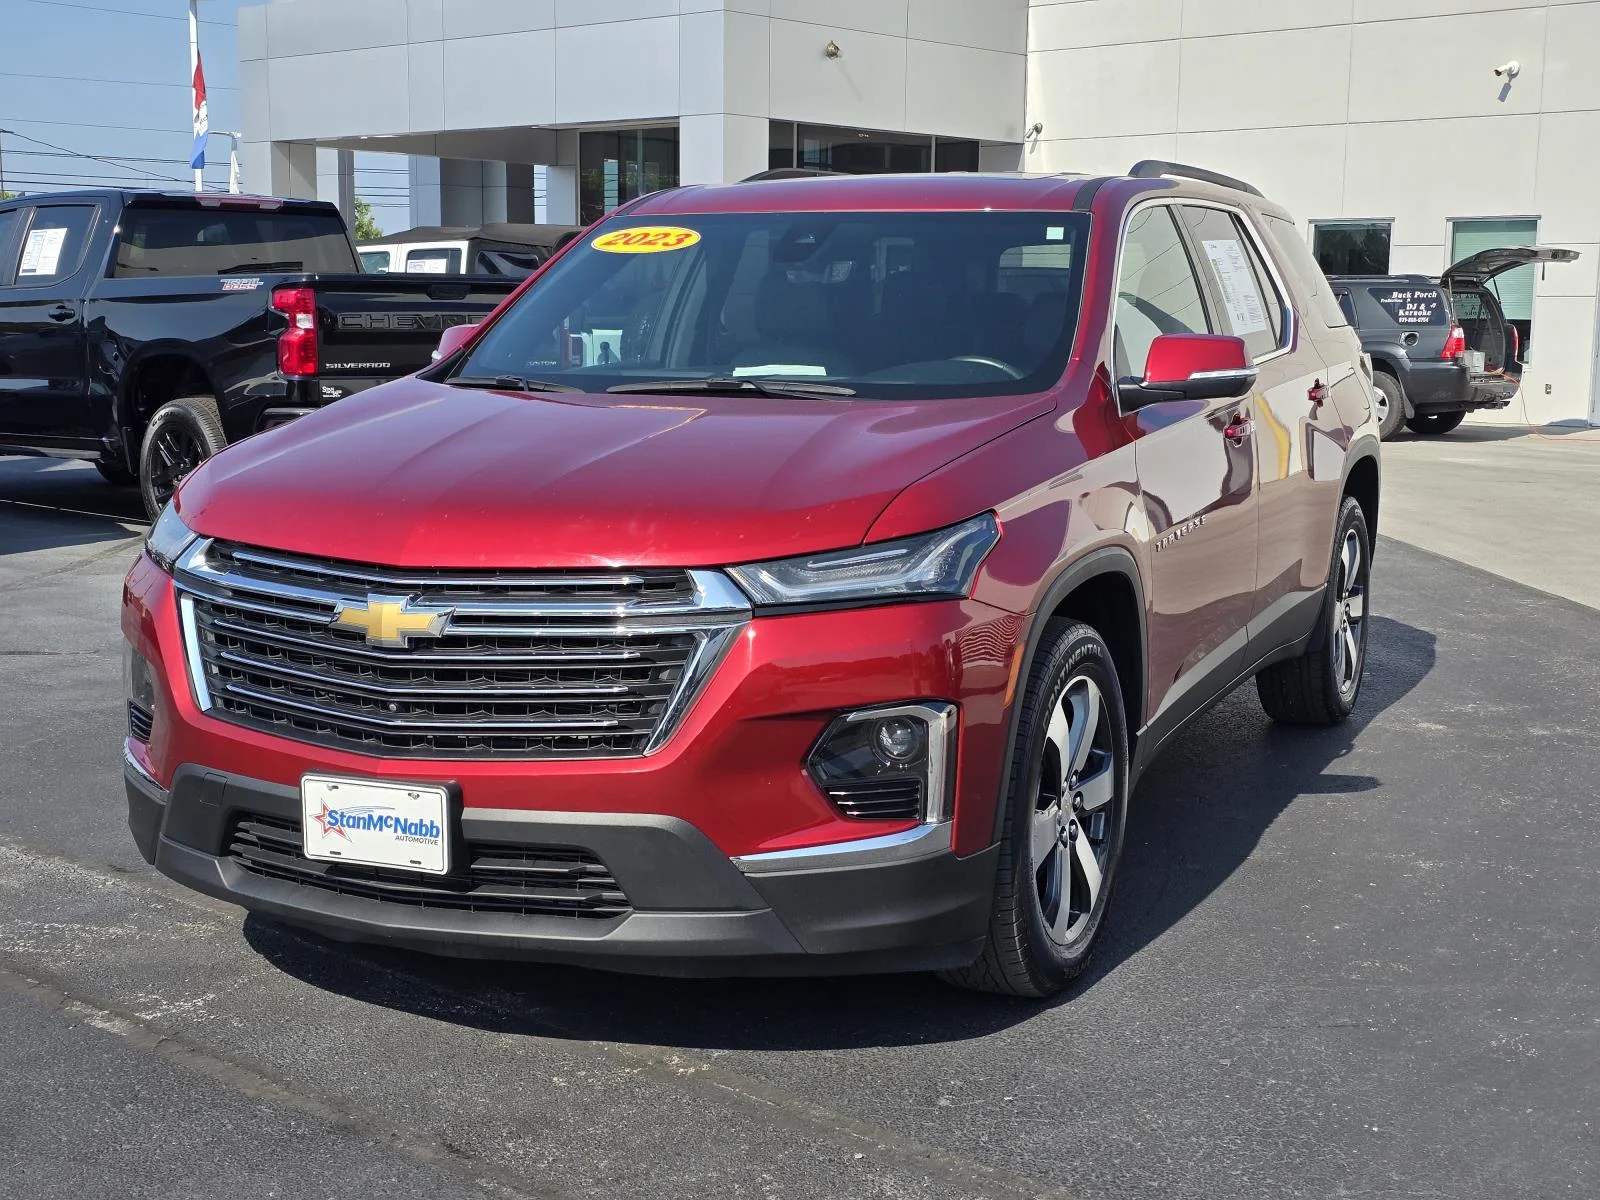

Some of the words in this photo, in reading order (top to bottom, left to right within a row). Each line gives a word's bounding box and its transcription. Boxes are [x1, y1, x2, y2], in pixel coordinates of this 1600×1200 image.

[600, 232, 693, 247] 2023
[1392, 291, 1412, 299] Back
[1155, 513, 1208, 552] TRAVERSE
[1043, 644, 1104, 732] CONTINENTAL
[395, 835, 439, 846] AUTOMOTIVE
